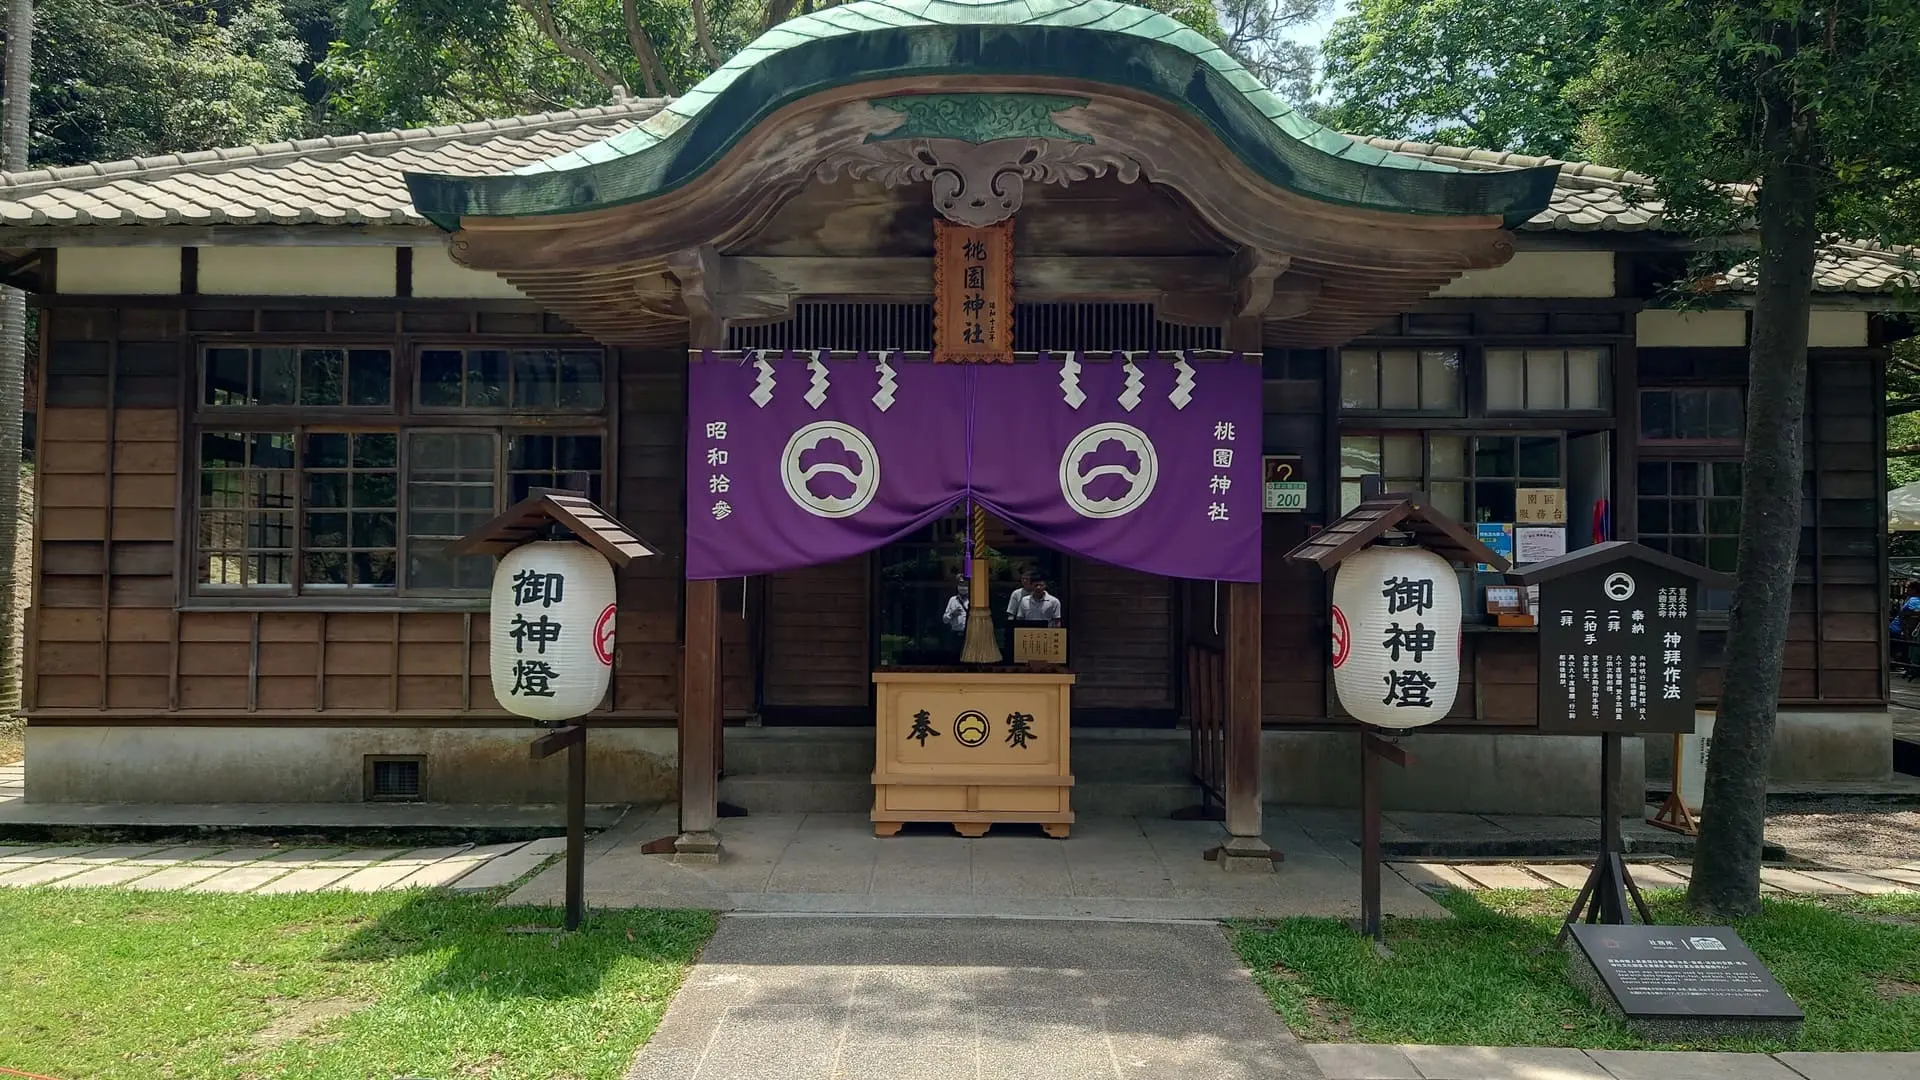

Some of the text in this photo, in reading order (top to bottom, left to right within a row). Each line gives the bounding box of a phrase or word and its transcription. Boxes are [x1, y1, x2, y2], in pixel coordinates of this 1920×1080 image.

[962, 237, 987, 344] 桃園神社
[706, 421, 732, 521] 昭和拾參
[1208, 421, 1235, 521] 桃園神社
[1276, 493, 1301, 507] 200
[1519, 508, 1562, 520] 服務台
[1527, 494, 1554, 505] 園區
[510, 569, 564, 697] 御神燈
[1560, 609, 1574, 627] 一拜
[1584, 609, 1598, 645] 二拍手
[1607, 609, 1621, 632] 二拜
[1631, 609, 1645, 634] 奉納
[1382, 577, 1437, 708] 御神燈
[1663, 631, 1682, 700] 神拜作法
[906, 709, 1038, 749] 奉 賽
